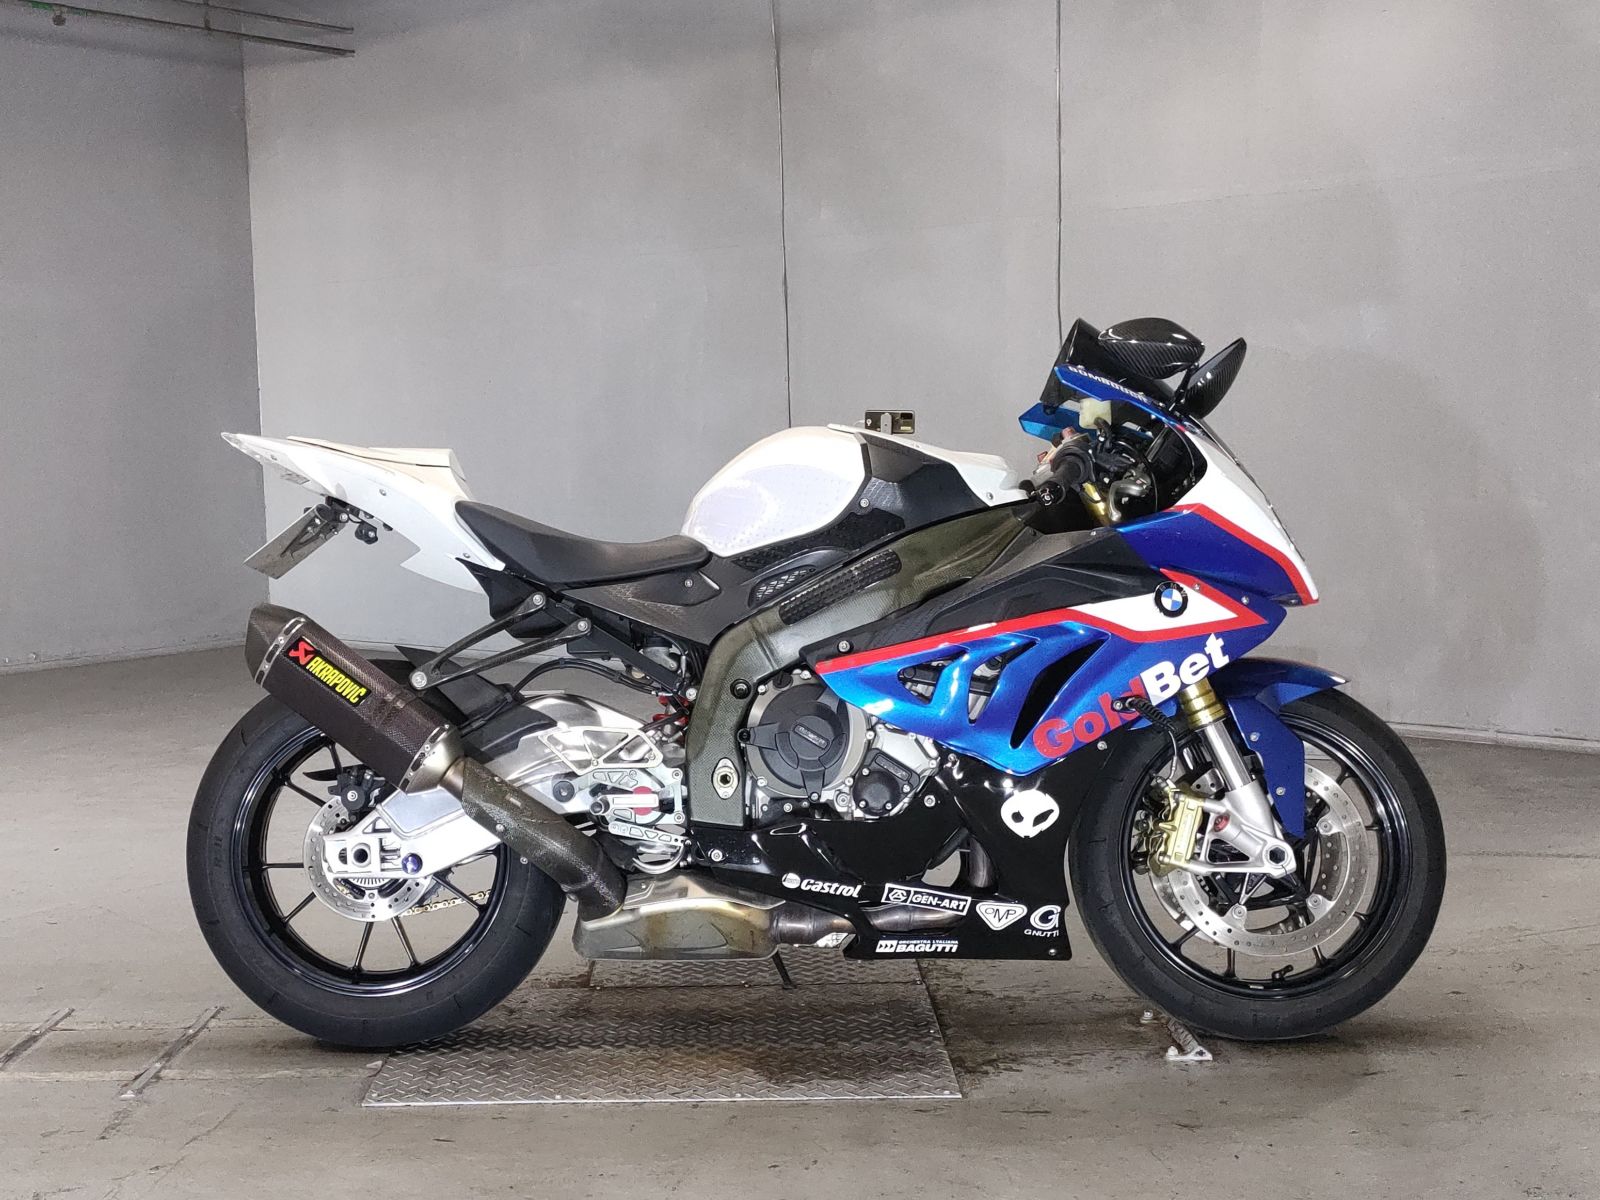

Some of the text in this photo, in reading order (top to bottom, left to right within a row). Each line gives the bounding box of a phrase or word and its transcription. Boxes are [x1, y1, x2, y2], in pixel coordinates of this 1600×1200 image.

[800, 878, 862, 898] Castrol
[911, 894, 967, 910] GEN-ART
[984, 907, 1017, 923] OMP
[1023, 928, 1060, 938] GNUTTI
[895, 943, 959, 953] BAGUTTI
